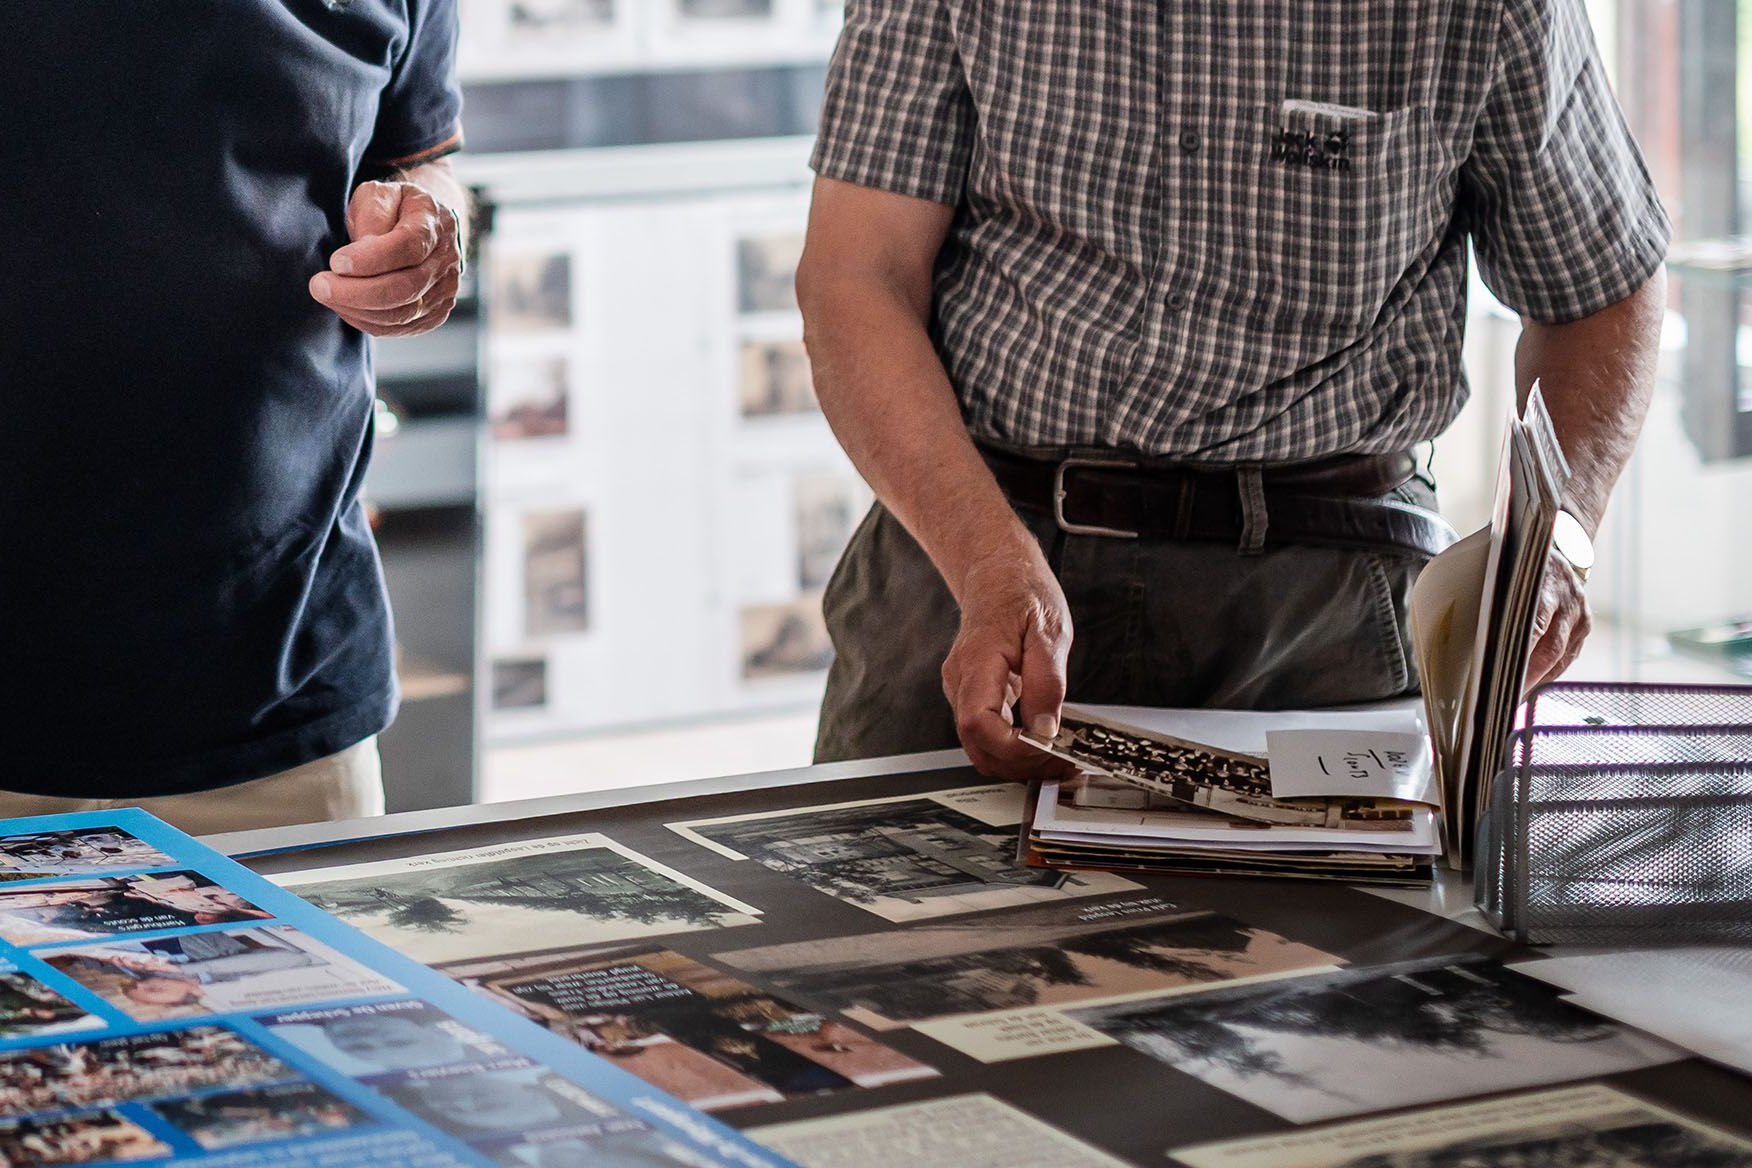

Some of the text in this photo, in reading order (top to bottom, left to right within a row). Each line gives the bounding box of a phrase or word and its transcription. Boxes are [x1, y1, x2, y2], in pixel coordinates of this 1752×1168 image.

[407, 859, 430, 868] kerk
[104, 918, 138, 926] scouts
[118, 919, 186, 931] Hamburgers
